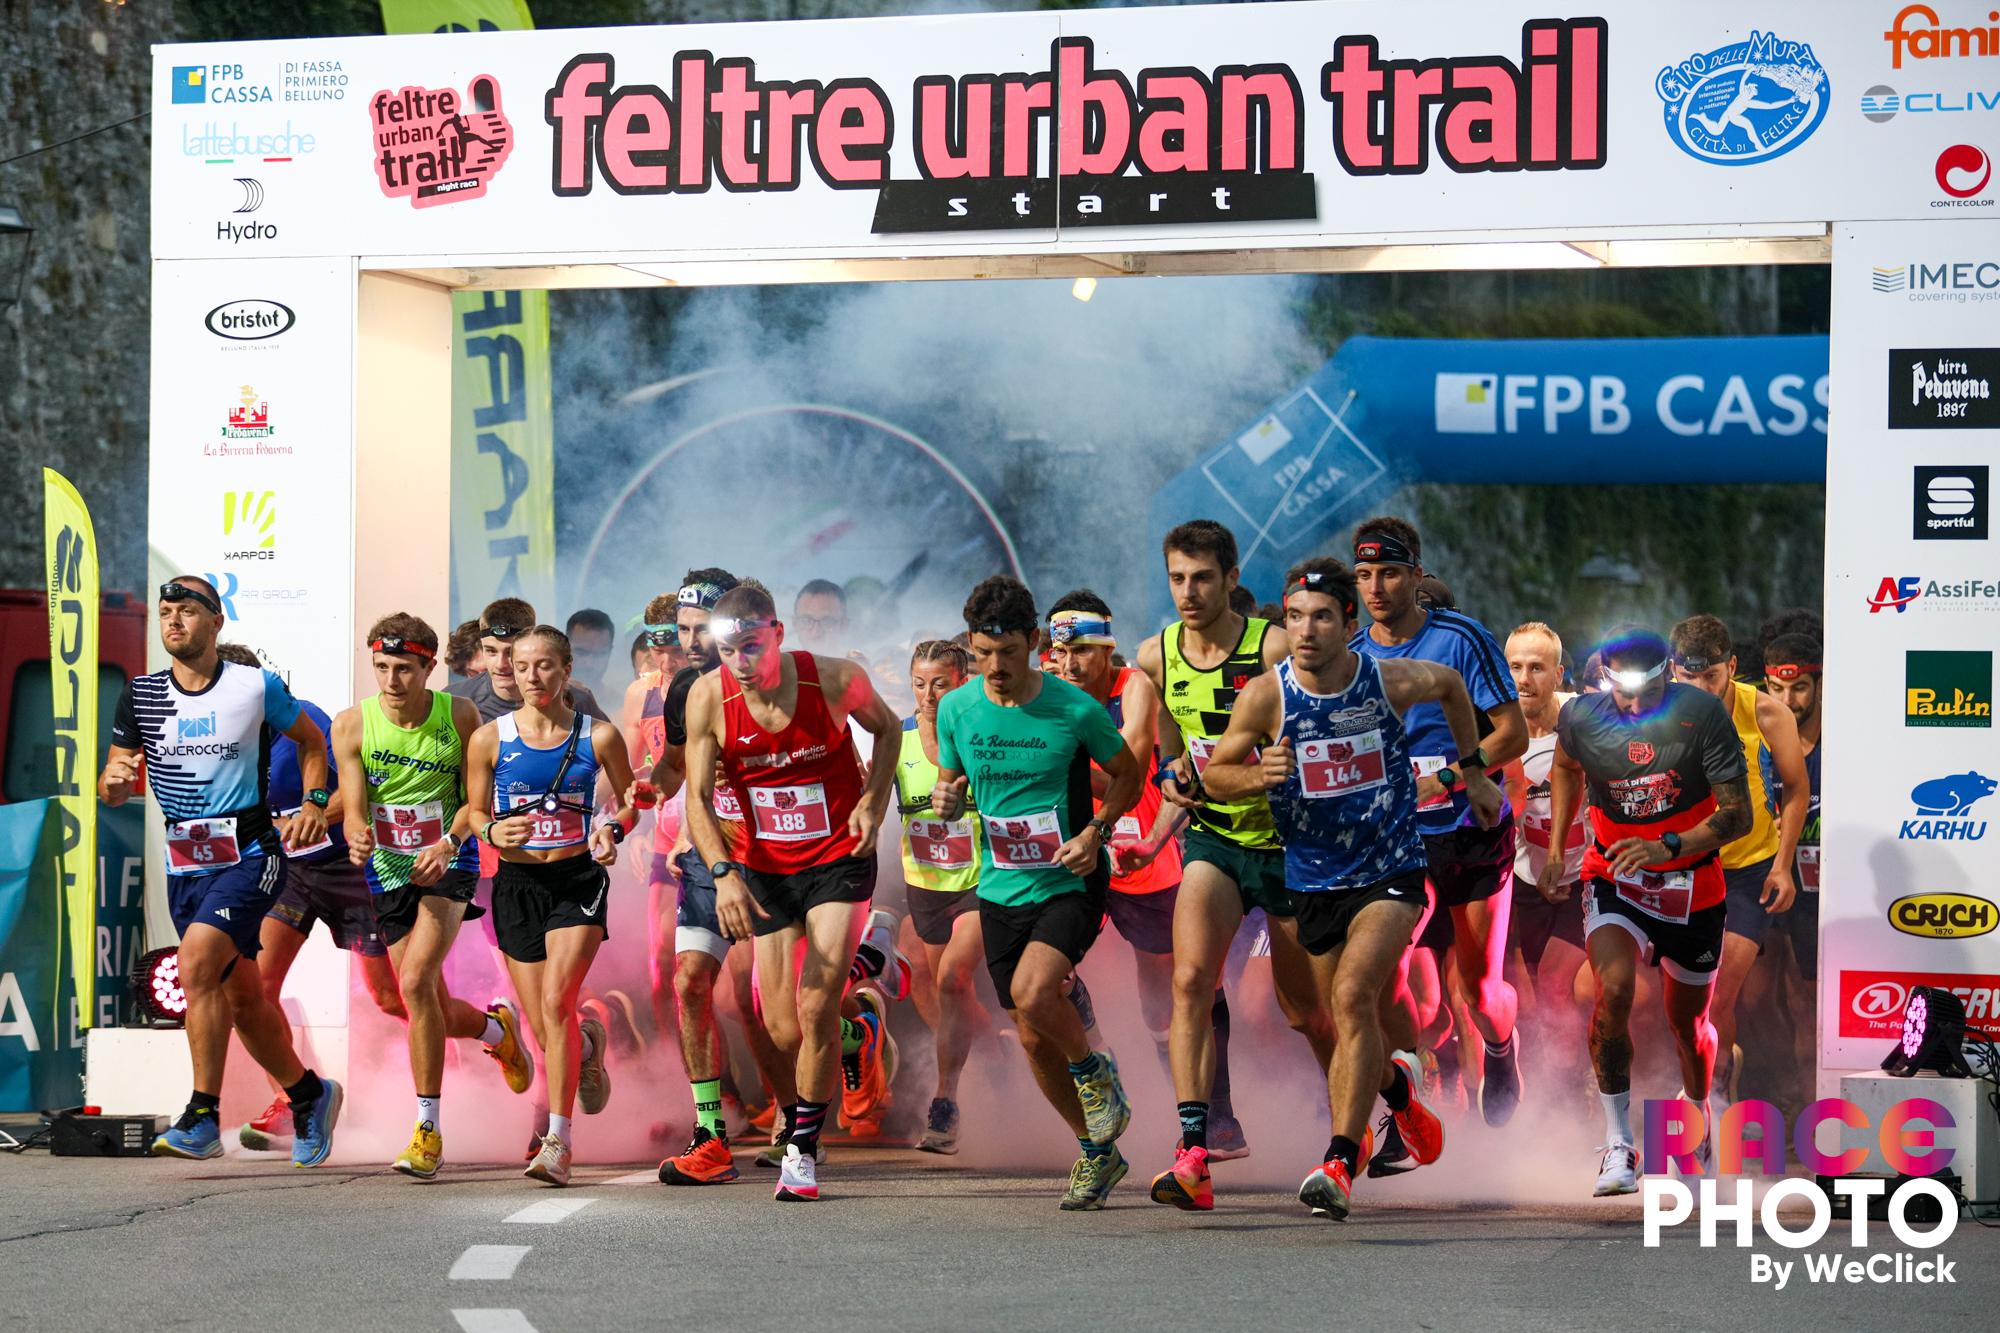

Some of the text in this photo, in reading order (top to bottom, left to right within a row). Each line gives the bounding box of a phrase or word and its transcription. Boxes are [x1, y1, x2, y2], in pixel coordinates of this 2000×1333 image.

[1884, 4, 2000, 69] fami
[211, 64, 244, 81] FPB
[285, 61, 343, 73] DI FASSA
[1657, 31, 1816, 101] GIRO DELLE MURA
[285, 74, 349, 87] PRIMIERO
[211, 86, 273, 104] CASSA
[285, 88, 345, 101] BELLUNO
[1905, 92, 2000, 112] CLIV
[375, 90, 454, 126] feltre
[550, 22, 1603, 192] feltre urban trail
[379, 126, 434, 147] urban
[1690, 103, 1804, 153] CITTÀ DI FELTRE
[183, 119, 316, 157] lattebusche
[380, 136, 461, 188] trail
[437, 180, 478, 192] night race
[1930, 200, 1995, 208] CONTECOLOR
[217, 220, 277, 244] Hydro
[1909, 262, 2000, 289] IMEC
[1909, 291, 1966, 303] covering
[221, 309, 279, 329] bristot
[1938, 358, 1968, 375] birra
[1911, 361, 1990, 407] Pedavena
[1504, 374, 1632, 436] FPB
[1936, 402, 1969, 417] 1897
[203, 442, 217, 456] La
[1283, 466, 1348, 517] CASSA
[1926, 517, 1975, 530] sportful
[241, 589, 308, 600] RR GROUP
[969, 733, 984, 746] La
[792, 744, 826, 758] atletica
[371, 749, 460, 774] alpenplus
[978, 764, 1038, 781] Sensitive
[1324, 764, 1362, 787] 144
[532, 820, 563, 838] 191
[772, 813, 806, 831] 188
[1898, 820, 1987, 840] KARHU
[391, 829, 423, 846] 165
[193, 845, 214, 861] 45
[929, 844, 949, 861] 50
[1007, 842, 1042, 860] 218
[1898, 903, 1988, 927] CRICH
